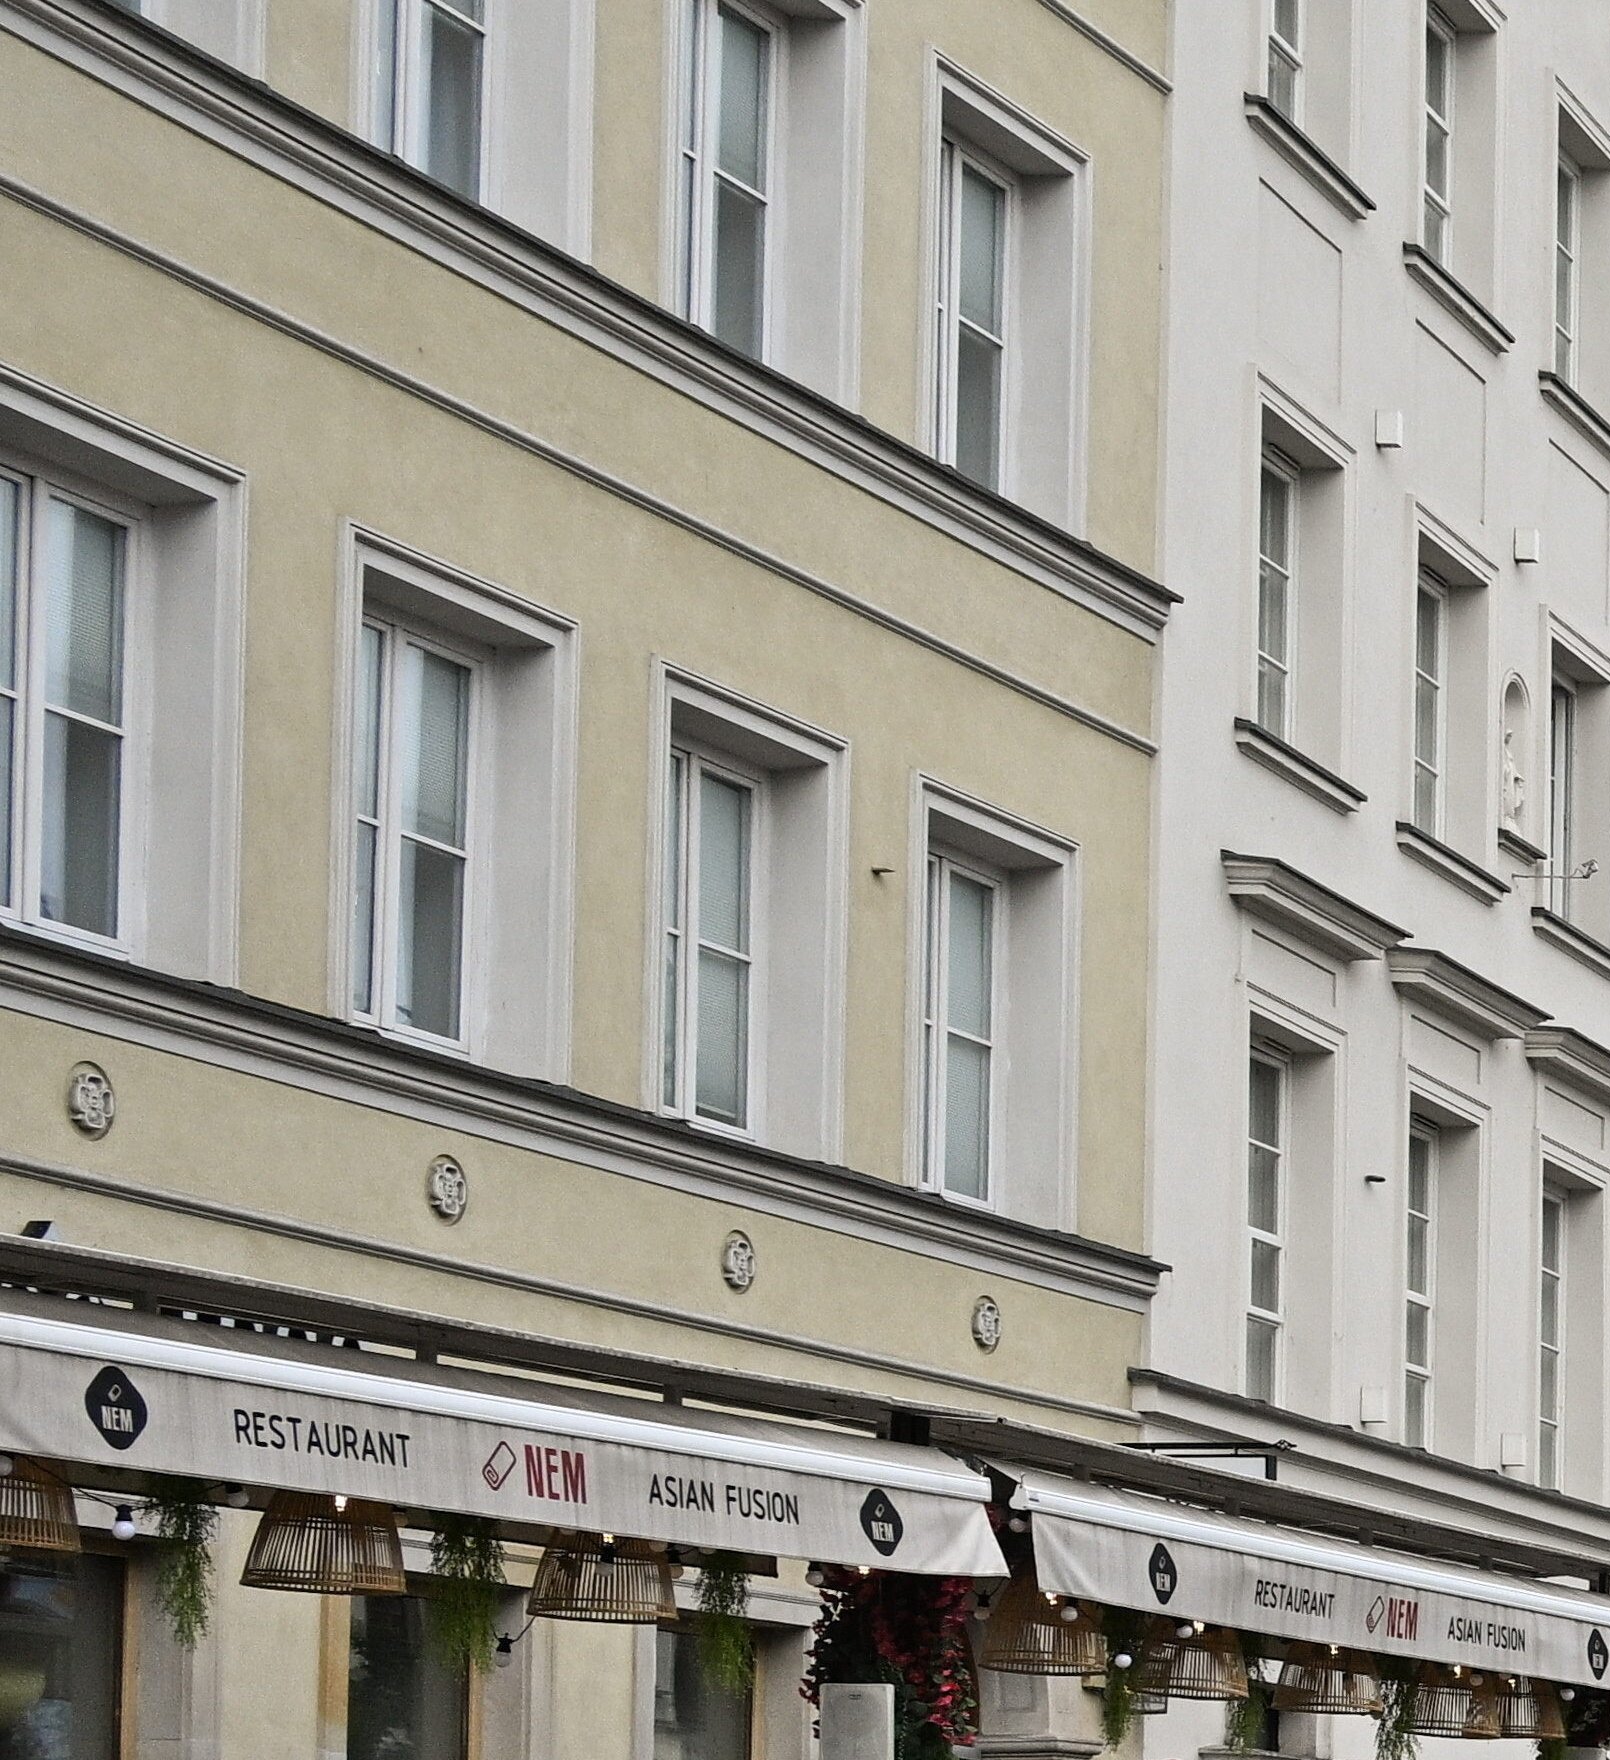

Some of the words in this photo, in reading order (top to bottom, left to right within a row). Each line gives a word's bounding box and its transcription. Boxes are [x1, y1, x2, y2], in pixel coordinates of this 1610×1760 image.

[101, 1405, 134, 1433] NEM
[234, 1409, 410, 1468] RESTAURANT
[524, 1444, 587, 1504] NEM
[648, 1473, 716, 1514] ASIAN
[725, 1484, 800, 1526] FUSION
[871, 1519, 894, 1543] NEM
[1255, 1579, 1335, 1619] RESTAURANT
[1386, 1597, 1419, 1641] NEM
[1447, 1616, 1482, 1645] ASIAN
[1487, 1623, 1526, 1652] FUSION
